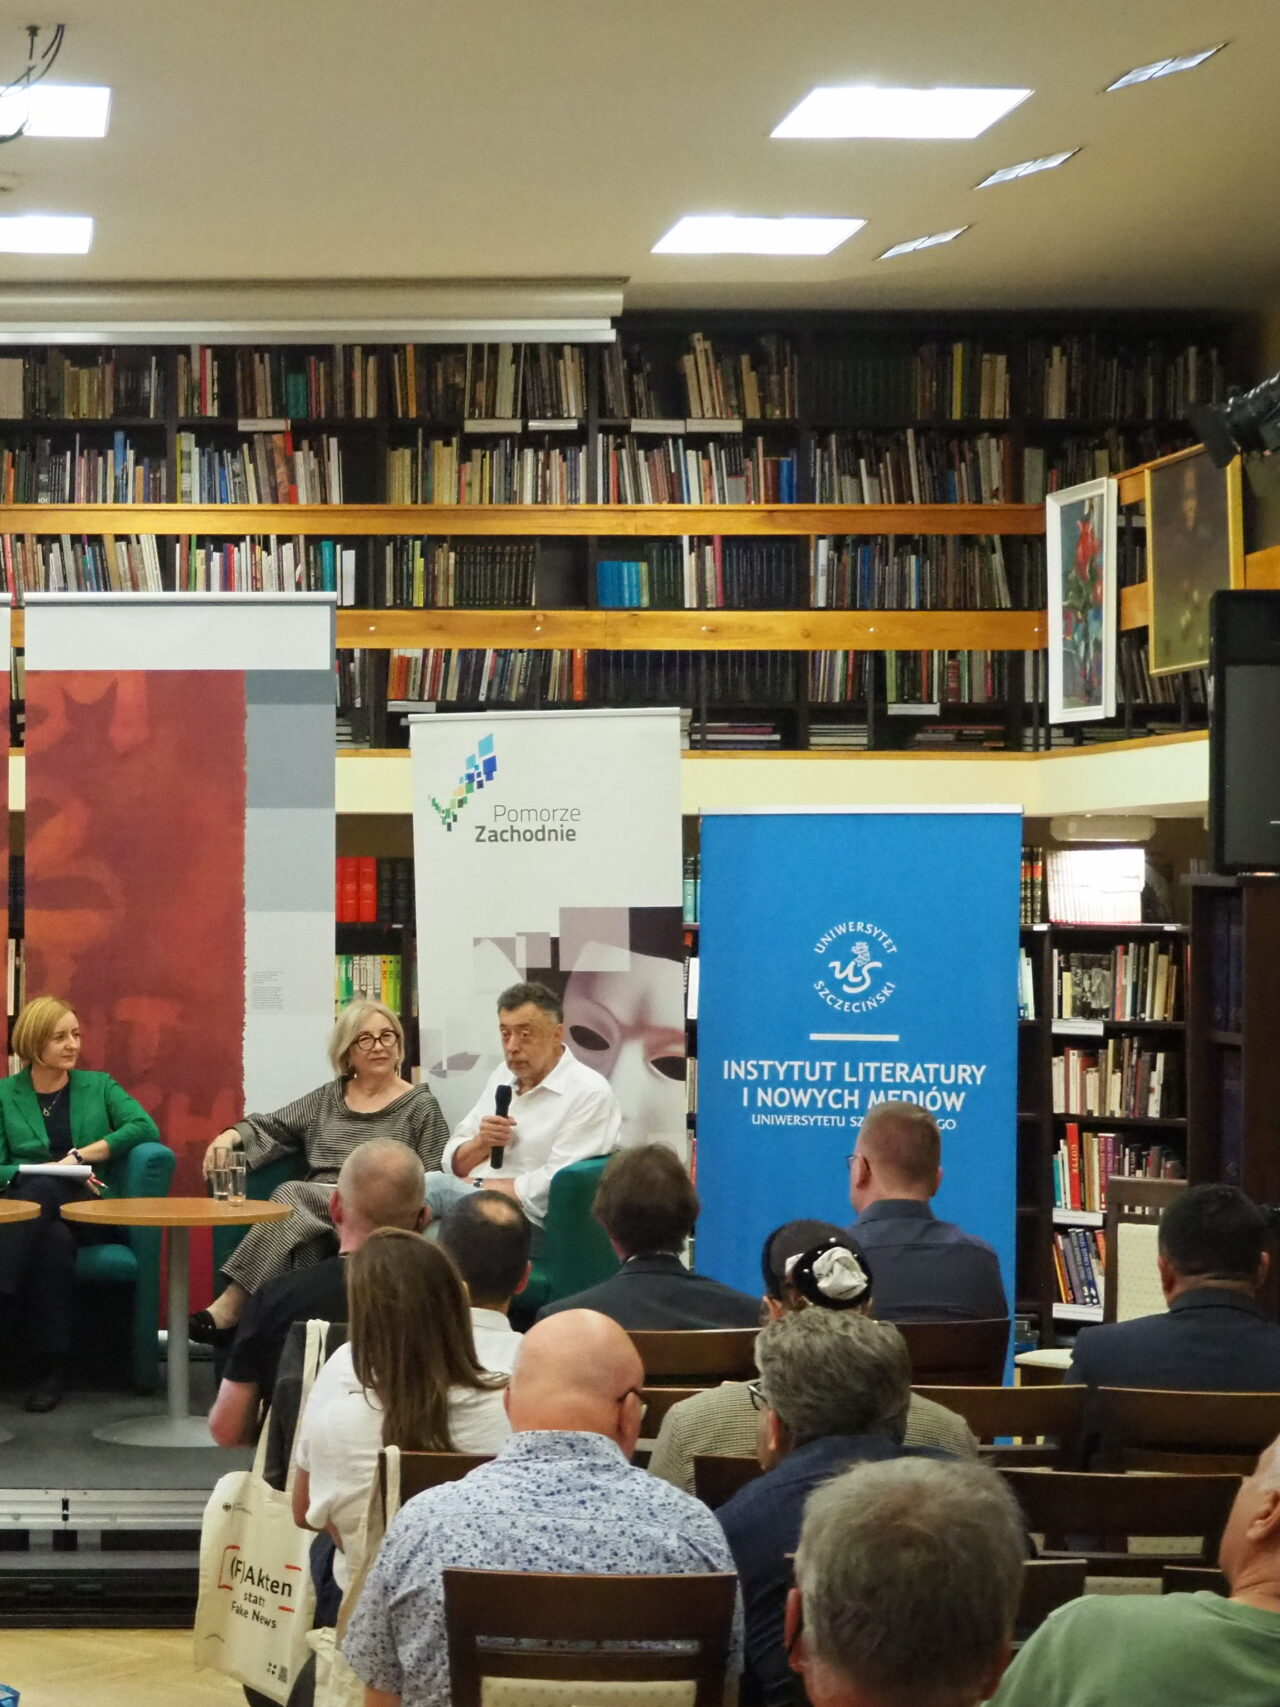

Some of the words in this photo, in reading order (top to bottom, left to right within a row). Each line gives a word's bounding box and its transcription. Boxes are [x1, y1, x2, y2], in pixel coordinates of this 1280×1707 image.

[494, 804, 581, 822] Pomorze
[474, 824, 577, 842] Zachodnie
[813, 921, 897, 954] UNIWERSYTET
[813, 980, 896, 1013] SZCZECIŃSKI
[723, 1060, 837, 1081] INSTYTUT
[844, 1062, 987, 1085] LITERATURY
[742, 1087, 748, 1107] I
[756, 1087, 859, 1109] NOWYCH
[752, 1114, 846, 1127] UNIWERSYTETU
[230, 1556, 292, 1598] (F)Akten
[243, 1591, 266, 1608] statt
[231, 1600, 249, 1618] Fake
[251, 1609, 277, 1629] News
